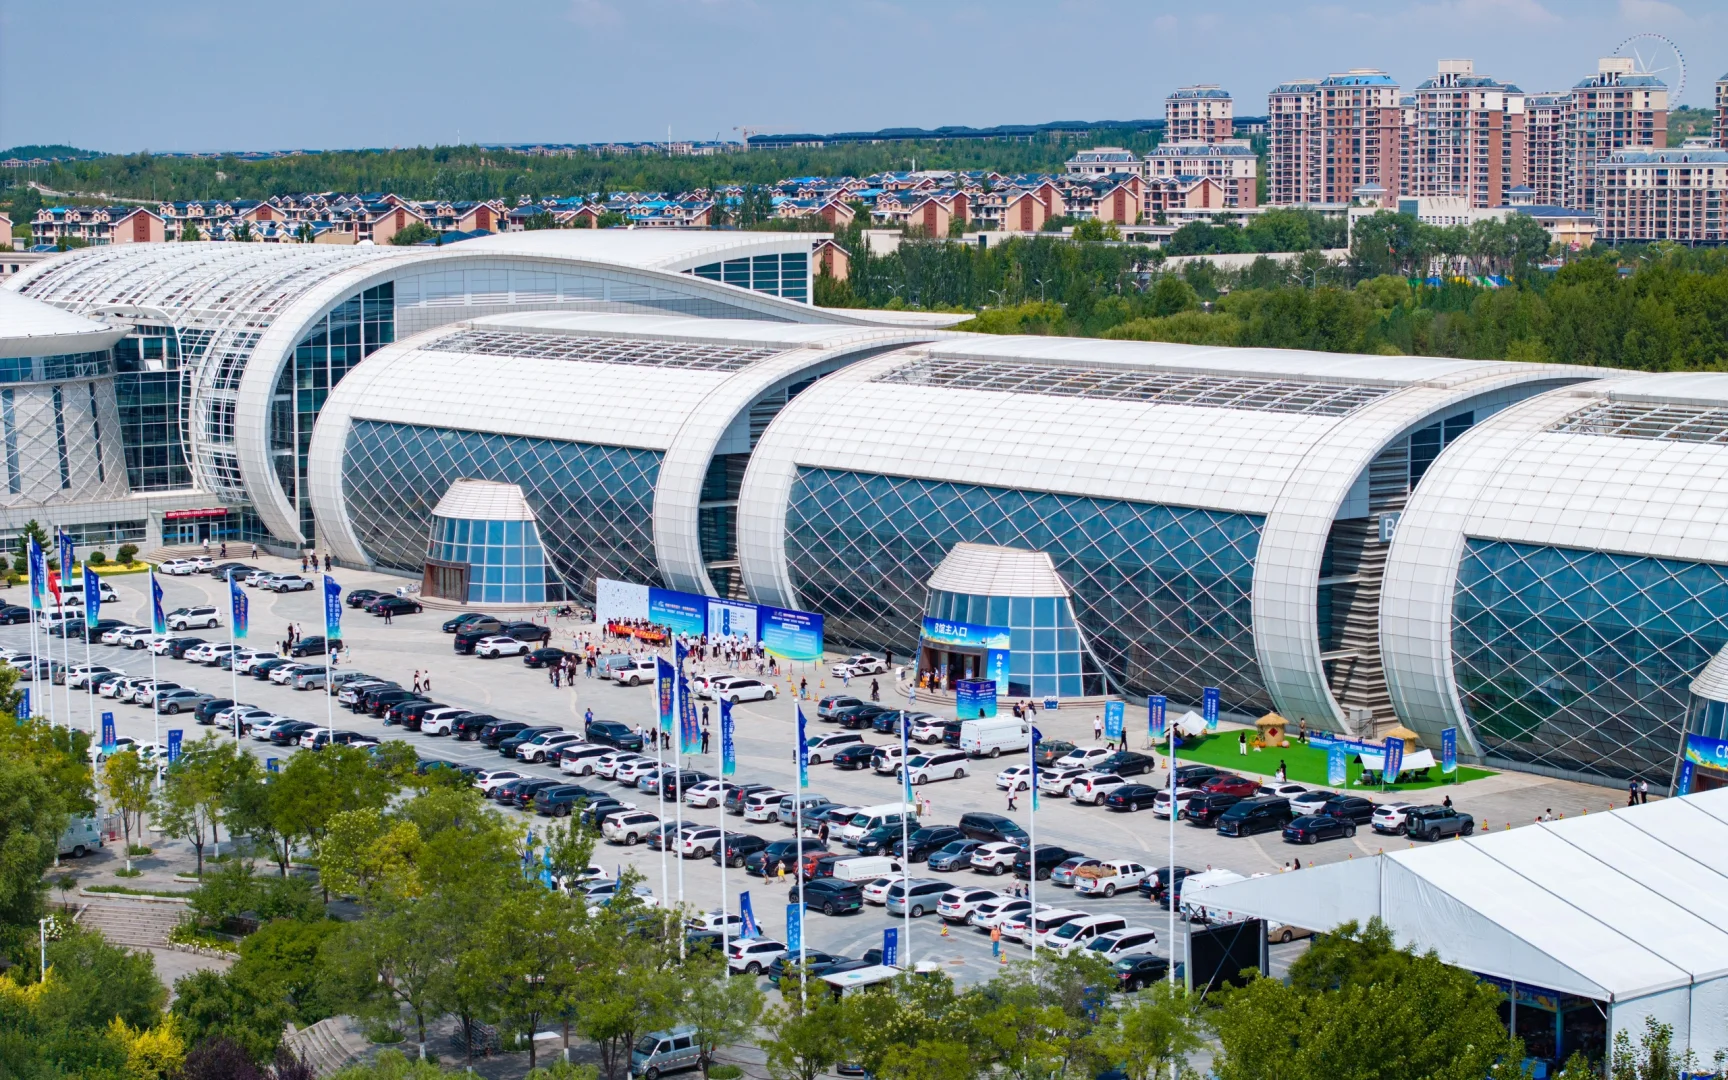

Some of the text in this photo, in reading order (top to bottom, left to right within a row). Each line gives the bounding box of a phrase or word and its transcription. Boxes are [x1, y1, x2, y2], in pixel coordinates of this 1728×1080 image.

[1384, 518, 1396, 540] B
[934, 622, 967, 637] B馆主入口
